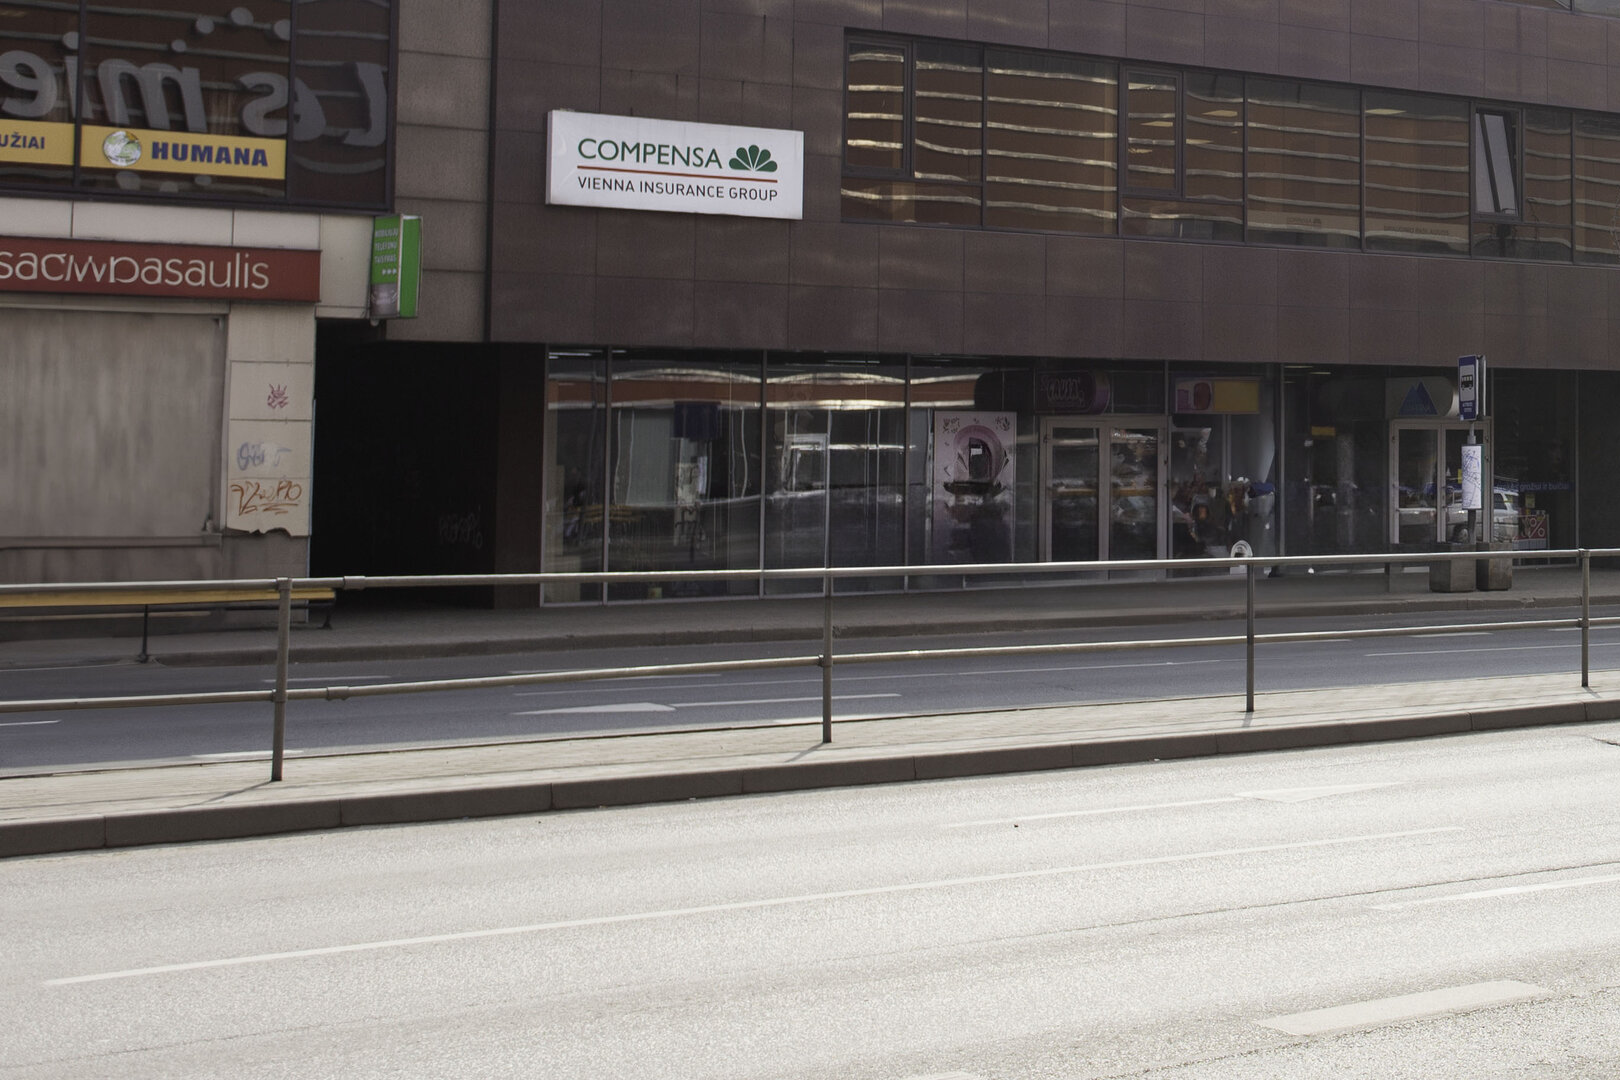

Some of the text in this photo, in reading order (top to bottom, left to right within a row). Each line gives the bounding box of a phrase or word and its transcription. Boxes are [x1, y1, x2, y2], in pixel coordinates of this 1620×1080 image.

[151, 140, 269, 167] HUMANA
[577, 138, 722, 169] COMPENSA
[577, 176, 778, 201] VIENNA INSURANCE GROUP
